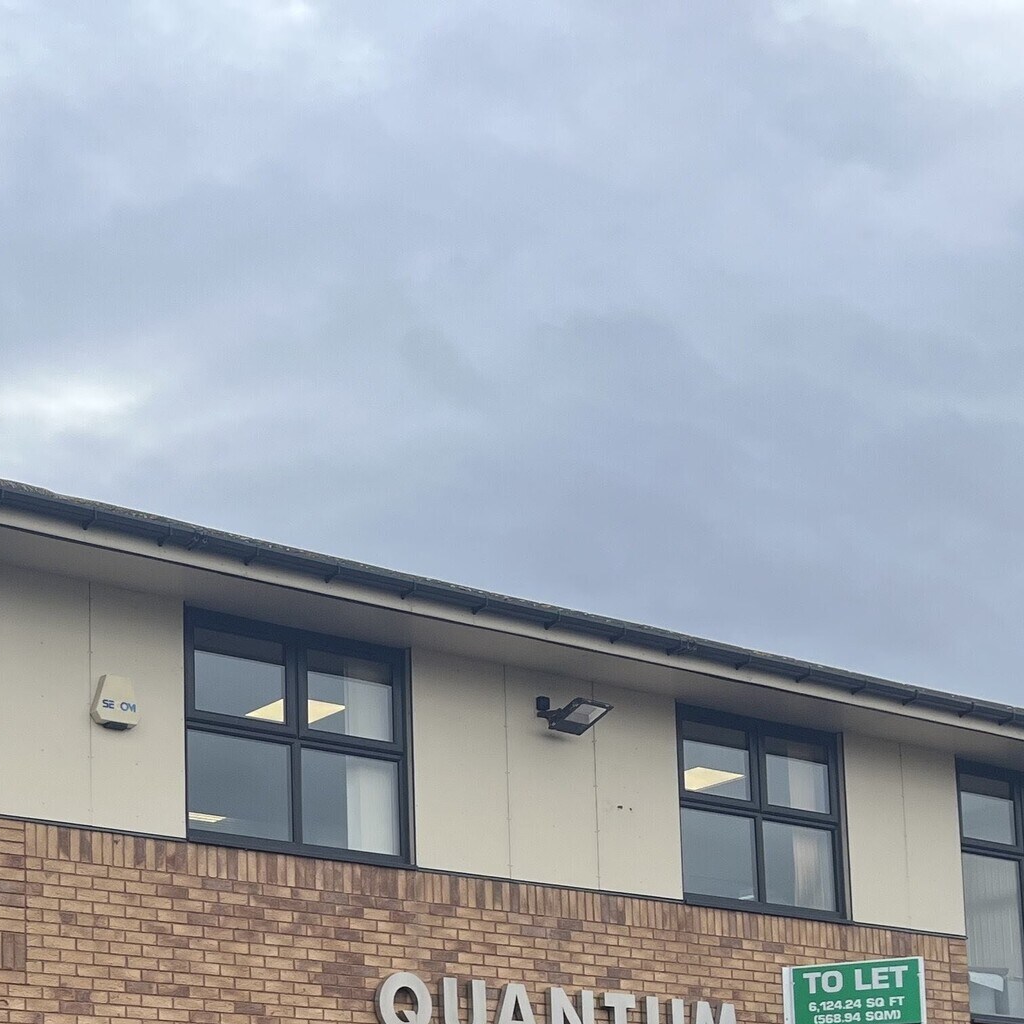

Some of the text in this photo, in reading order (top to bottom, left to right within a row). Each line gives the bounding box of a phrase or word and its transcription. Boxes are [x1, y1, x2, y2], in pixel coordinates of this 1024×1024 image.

[803, 965, 909, 994] TO LET
[808, 996, 905, 1012] 6,124.24 SQ FT
[814, 1010, 901, 1024] (568.94 SQM)
